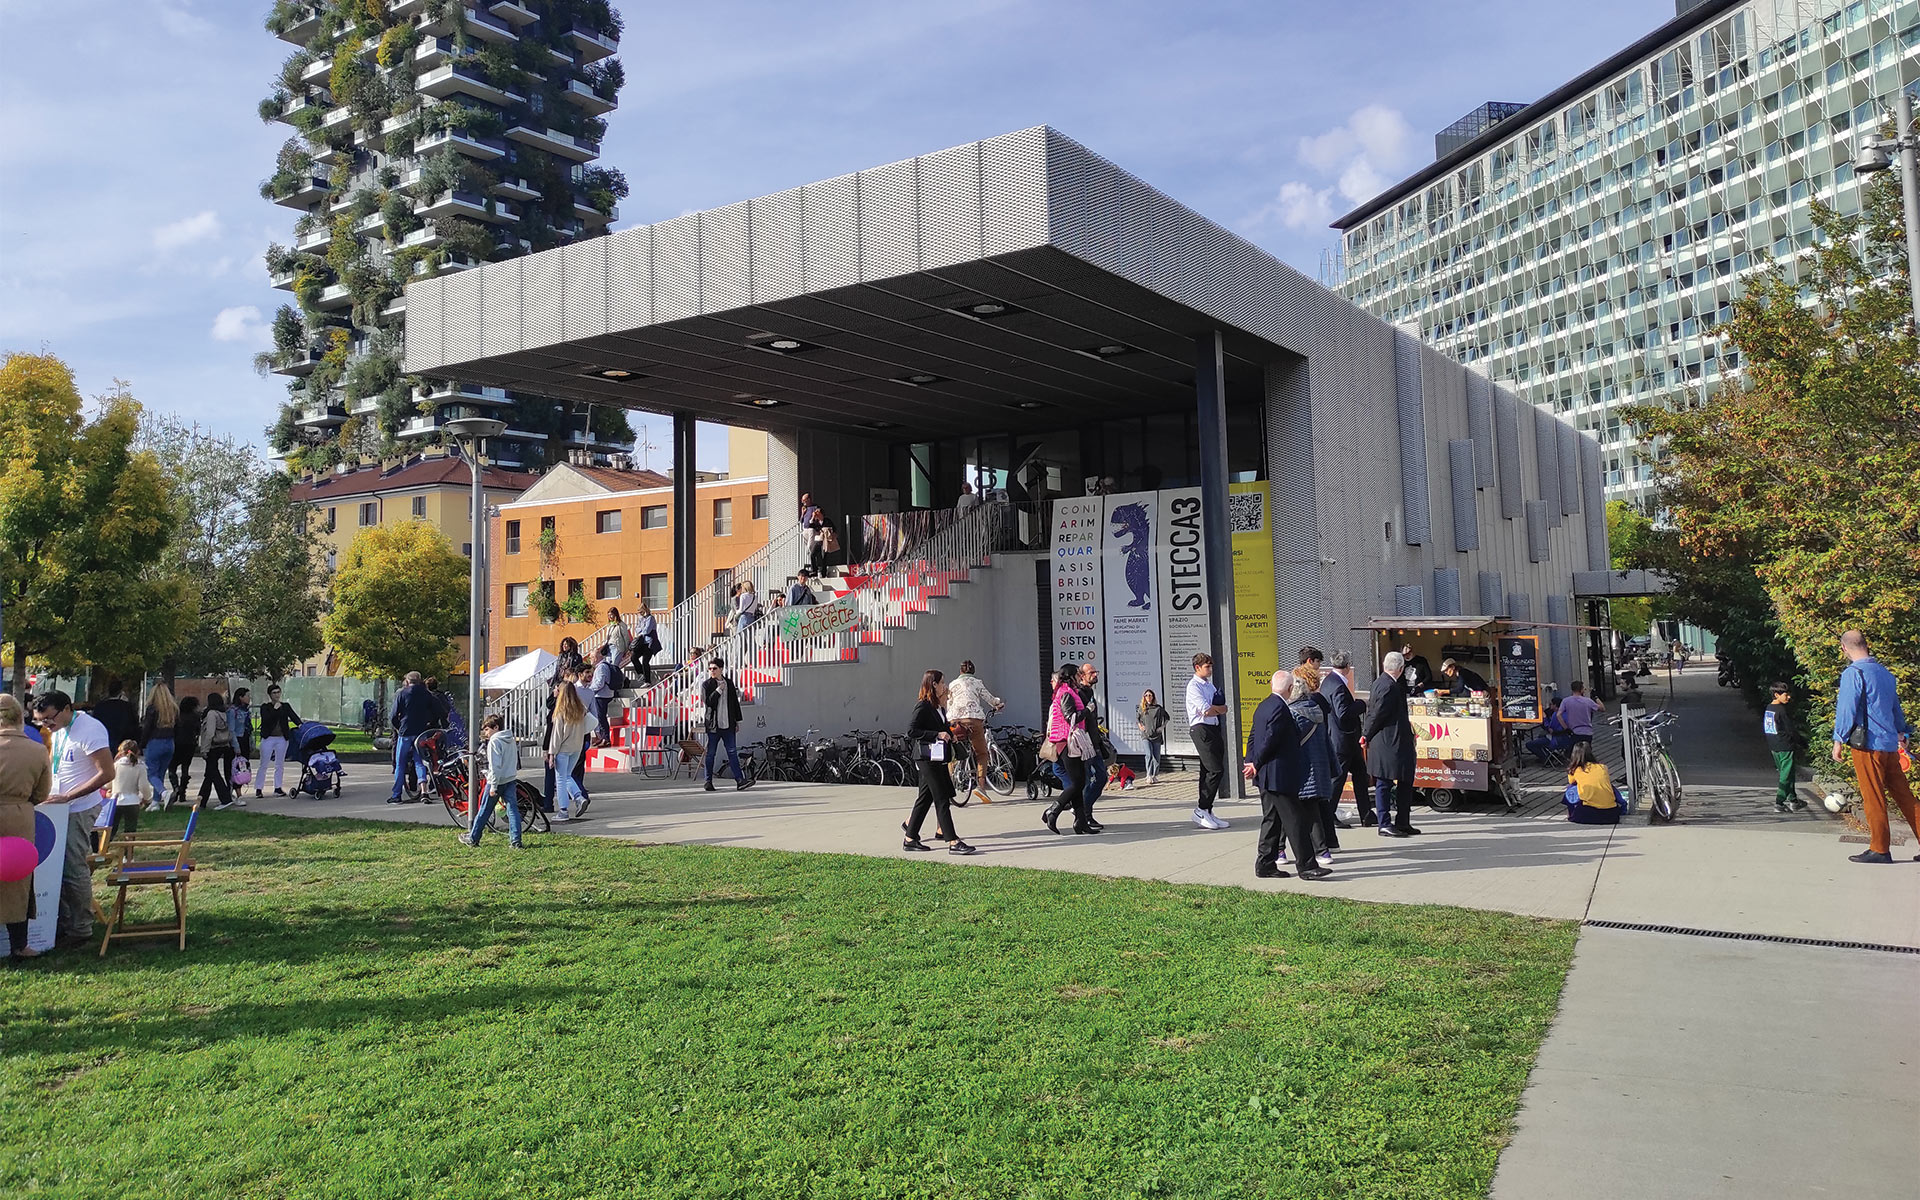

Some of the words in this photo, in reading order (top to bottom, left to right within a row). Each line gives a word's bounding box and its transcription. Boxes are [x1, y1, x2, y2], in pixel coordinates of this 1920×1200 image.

[1061, 504, 1096, 515] CONI
[1060, 518, 1095, 529] ARIM
[1059, 532, 1094, 542] REPAR
[1057, 546, 1093, 558] QUAR
[1170, 497, 1202, 611] STECCA3
[1058, 562, 1093, 572] ASIS
[1058, 577, 1094, 587] BRISI
[1058, 591, 1094, 601] PREDI
[1059, 606, 1095, 616] TEVITI
[1060, 620, 1095, 630] VITIDO
[1060, 636, 1095, 645] SISTEN
[1060, 650, 1096, 660] PERO
[1444, 767, 1451, 775] di
